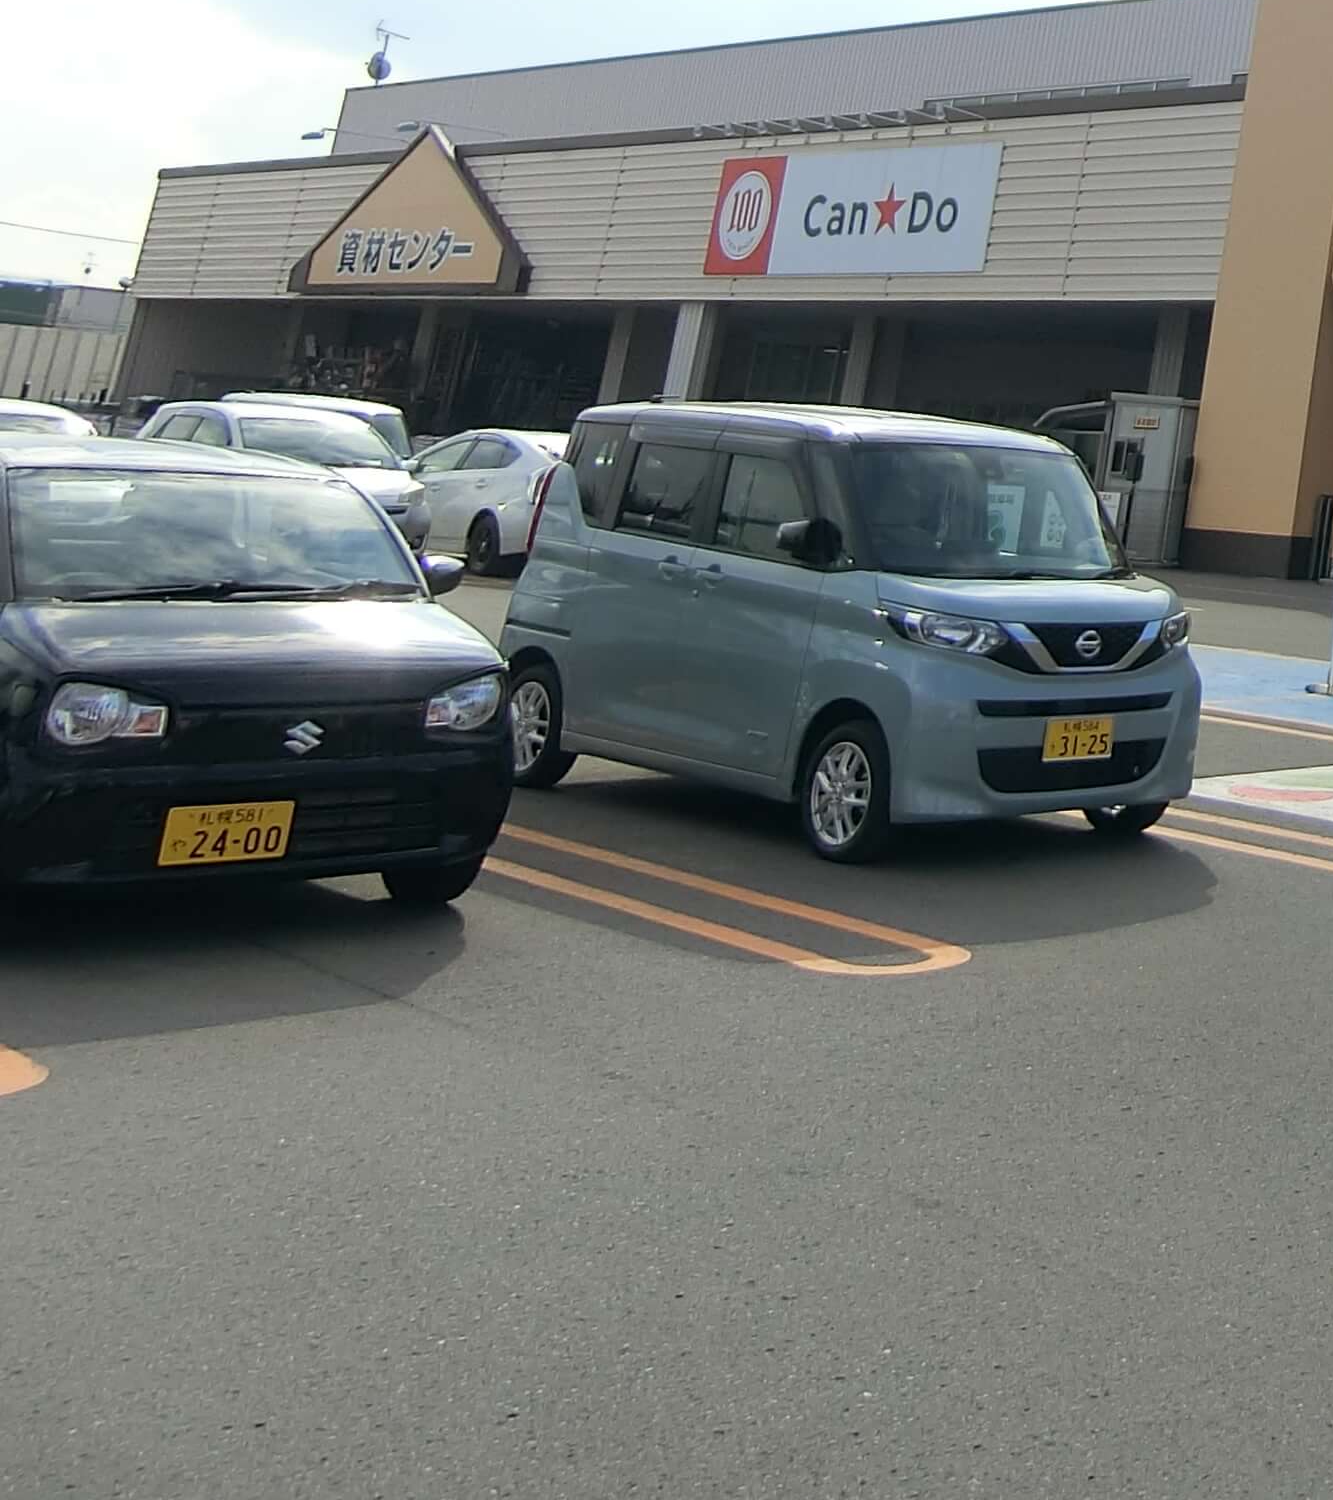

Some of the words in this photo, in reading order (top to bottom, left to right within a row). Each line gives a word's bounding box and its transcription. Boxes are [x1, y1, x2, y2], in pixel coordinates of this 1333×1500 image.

[727, 187, 764, 234] 100
[335, 227, 474, 276] 資材センター
[1059, 733, 1109, 756] 31-25
[188, 825, 283, 859] 24-00
